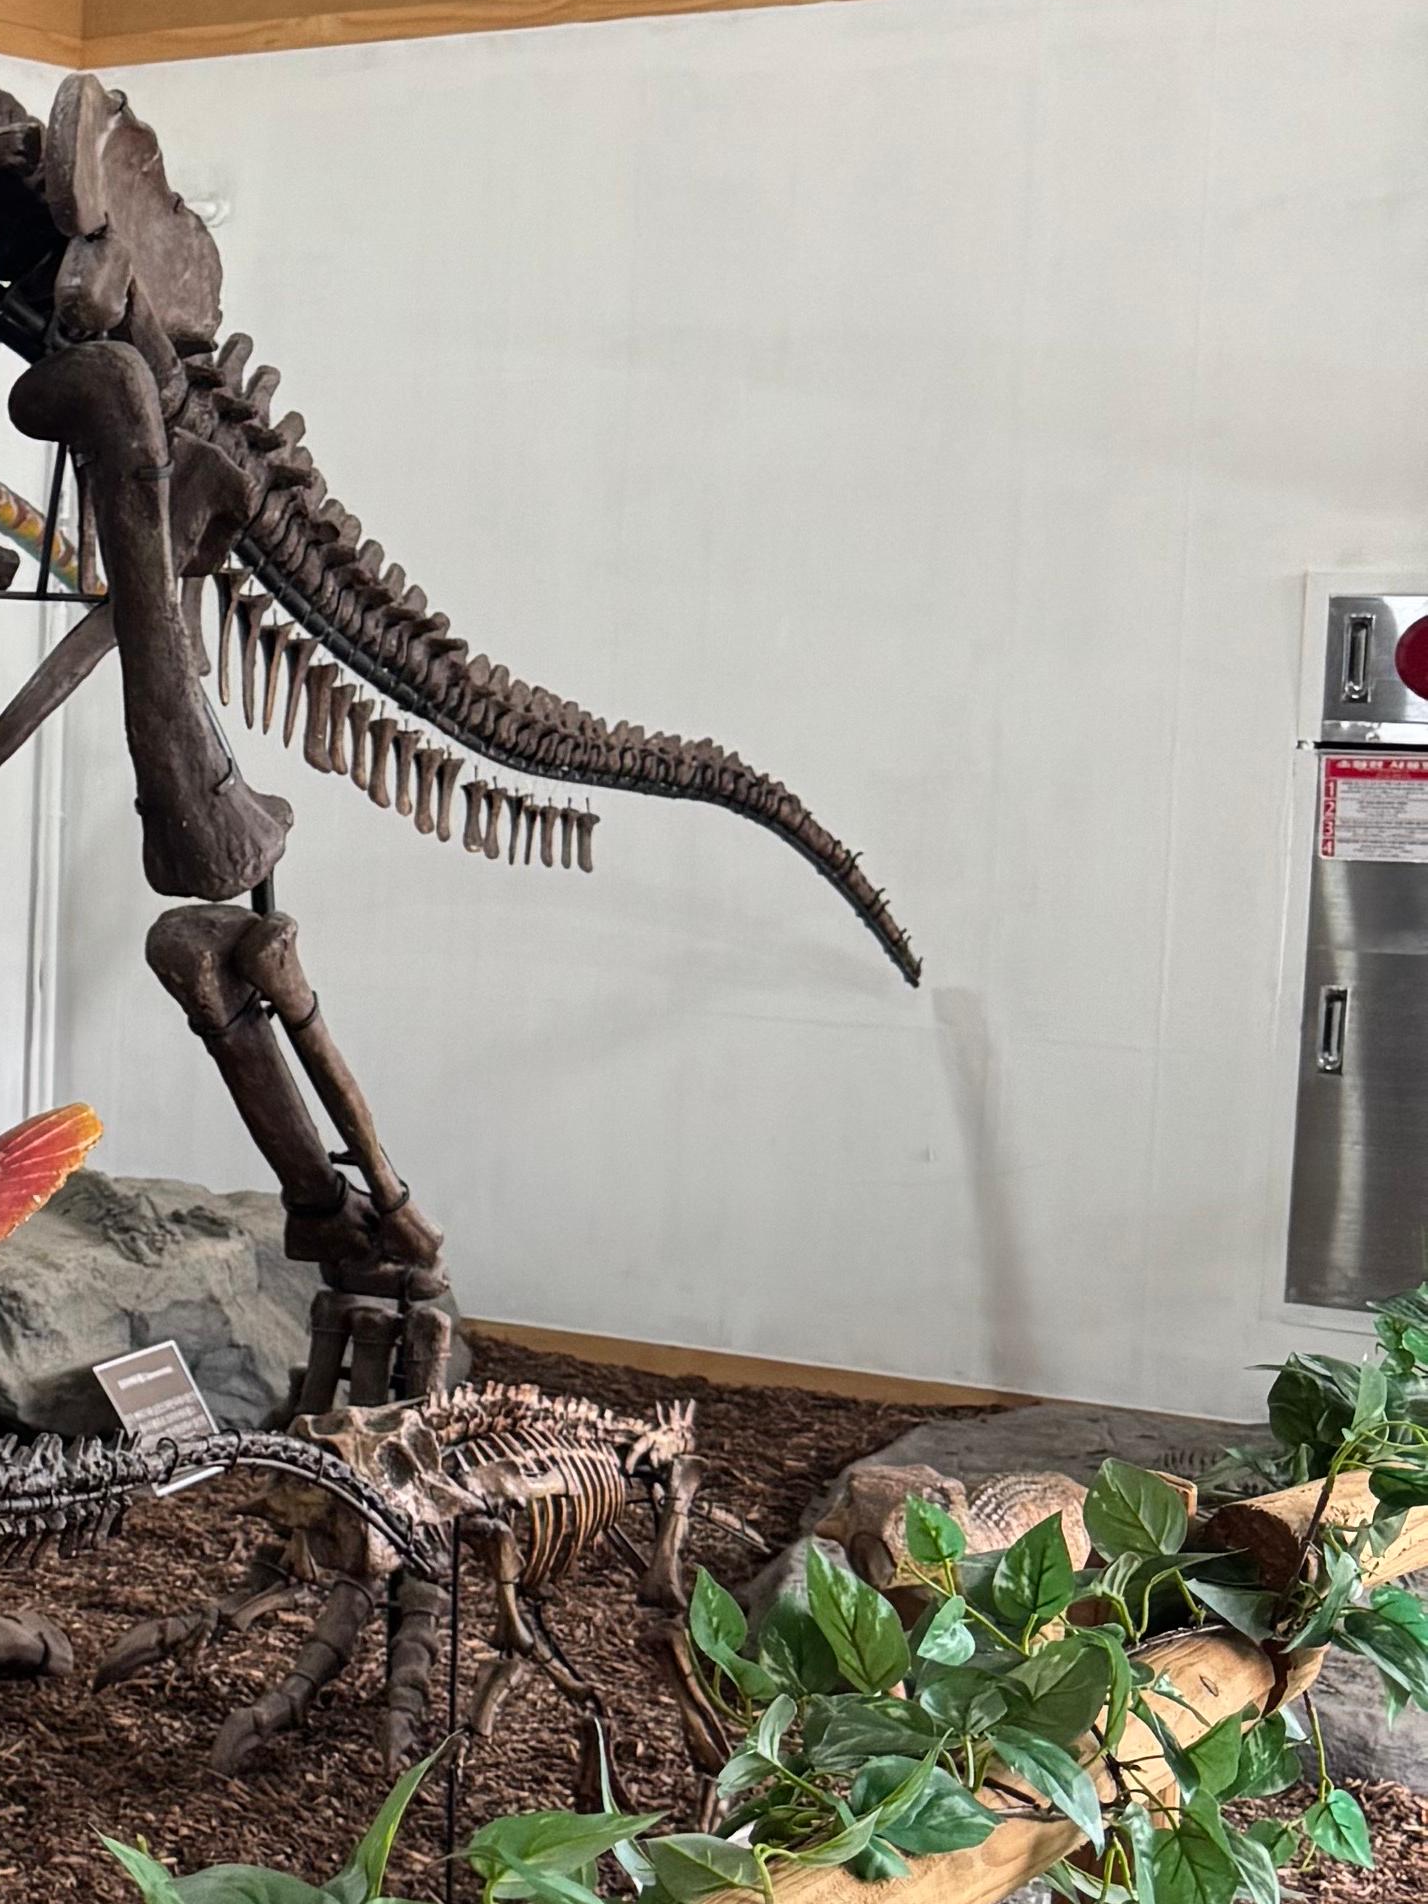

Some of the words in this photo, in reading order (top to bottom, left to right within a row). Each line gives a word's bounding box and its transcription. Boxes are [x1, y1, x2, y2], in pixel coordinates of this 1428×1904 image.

[1327, 782, 1334, 796] 1
[1325, 802, 1334, 814] 2
[1324, 821, 1333, 833] 3
[1323, 840, 1332, 853] 4
